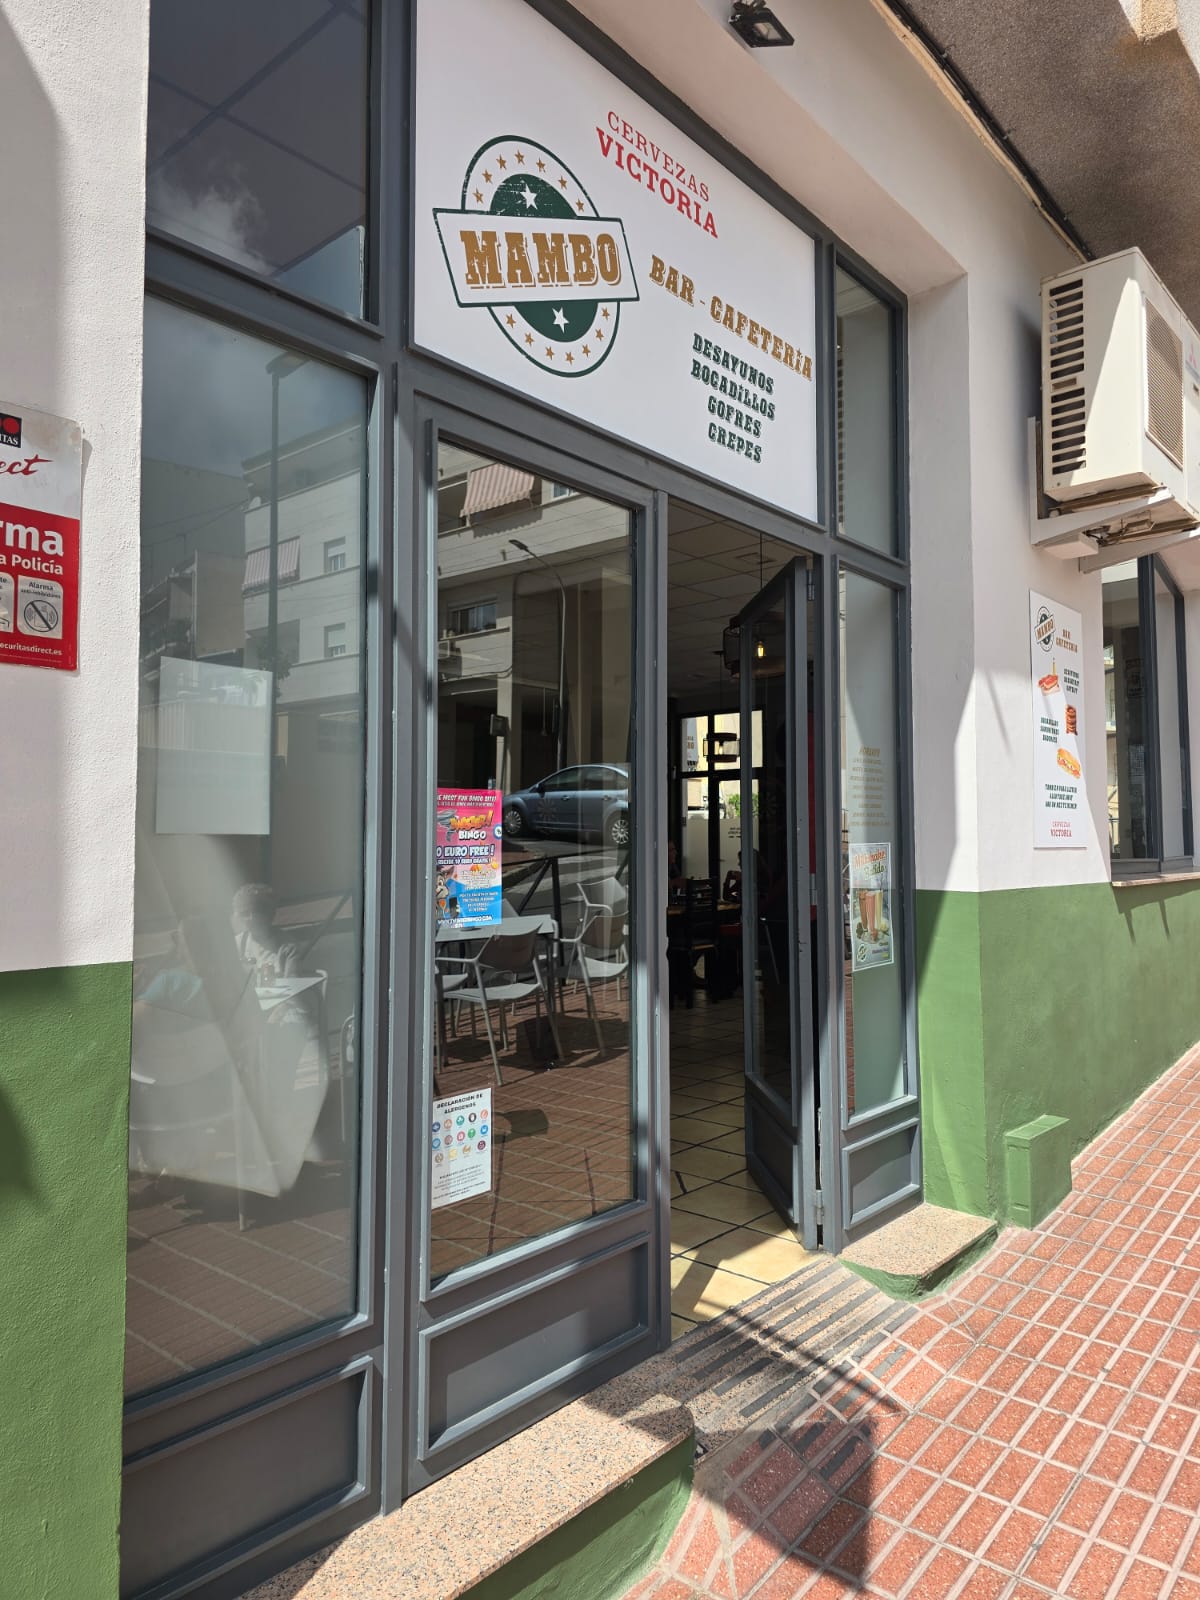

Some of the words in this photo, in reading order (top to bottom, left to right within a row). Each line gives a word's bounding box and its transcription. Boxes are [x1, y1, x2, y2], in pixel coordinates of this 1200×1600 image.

[607, 111, 709, 202] CERVEZAS
[596, 126, 719, 239] VICTORIA
[459, 230, 622, 289] MAMBO
[648, 253, 695, 307] BAR
[692, 332, 775, 395] DESAYUNOS
[707, 395, 762, 438] GOFRES
[707, 422, 763, 464] CREPES
[0, 520, 64, 557] ma
[11, 552, 64, 576] Policía
[29, 581, 54, 591] Alarma
[444, 846, 468, 857] EURO
[469, 846, 489, 857] FREE
[458, 830, 487, 840] BINGO
